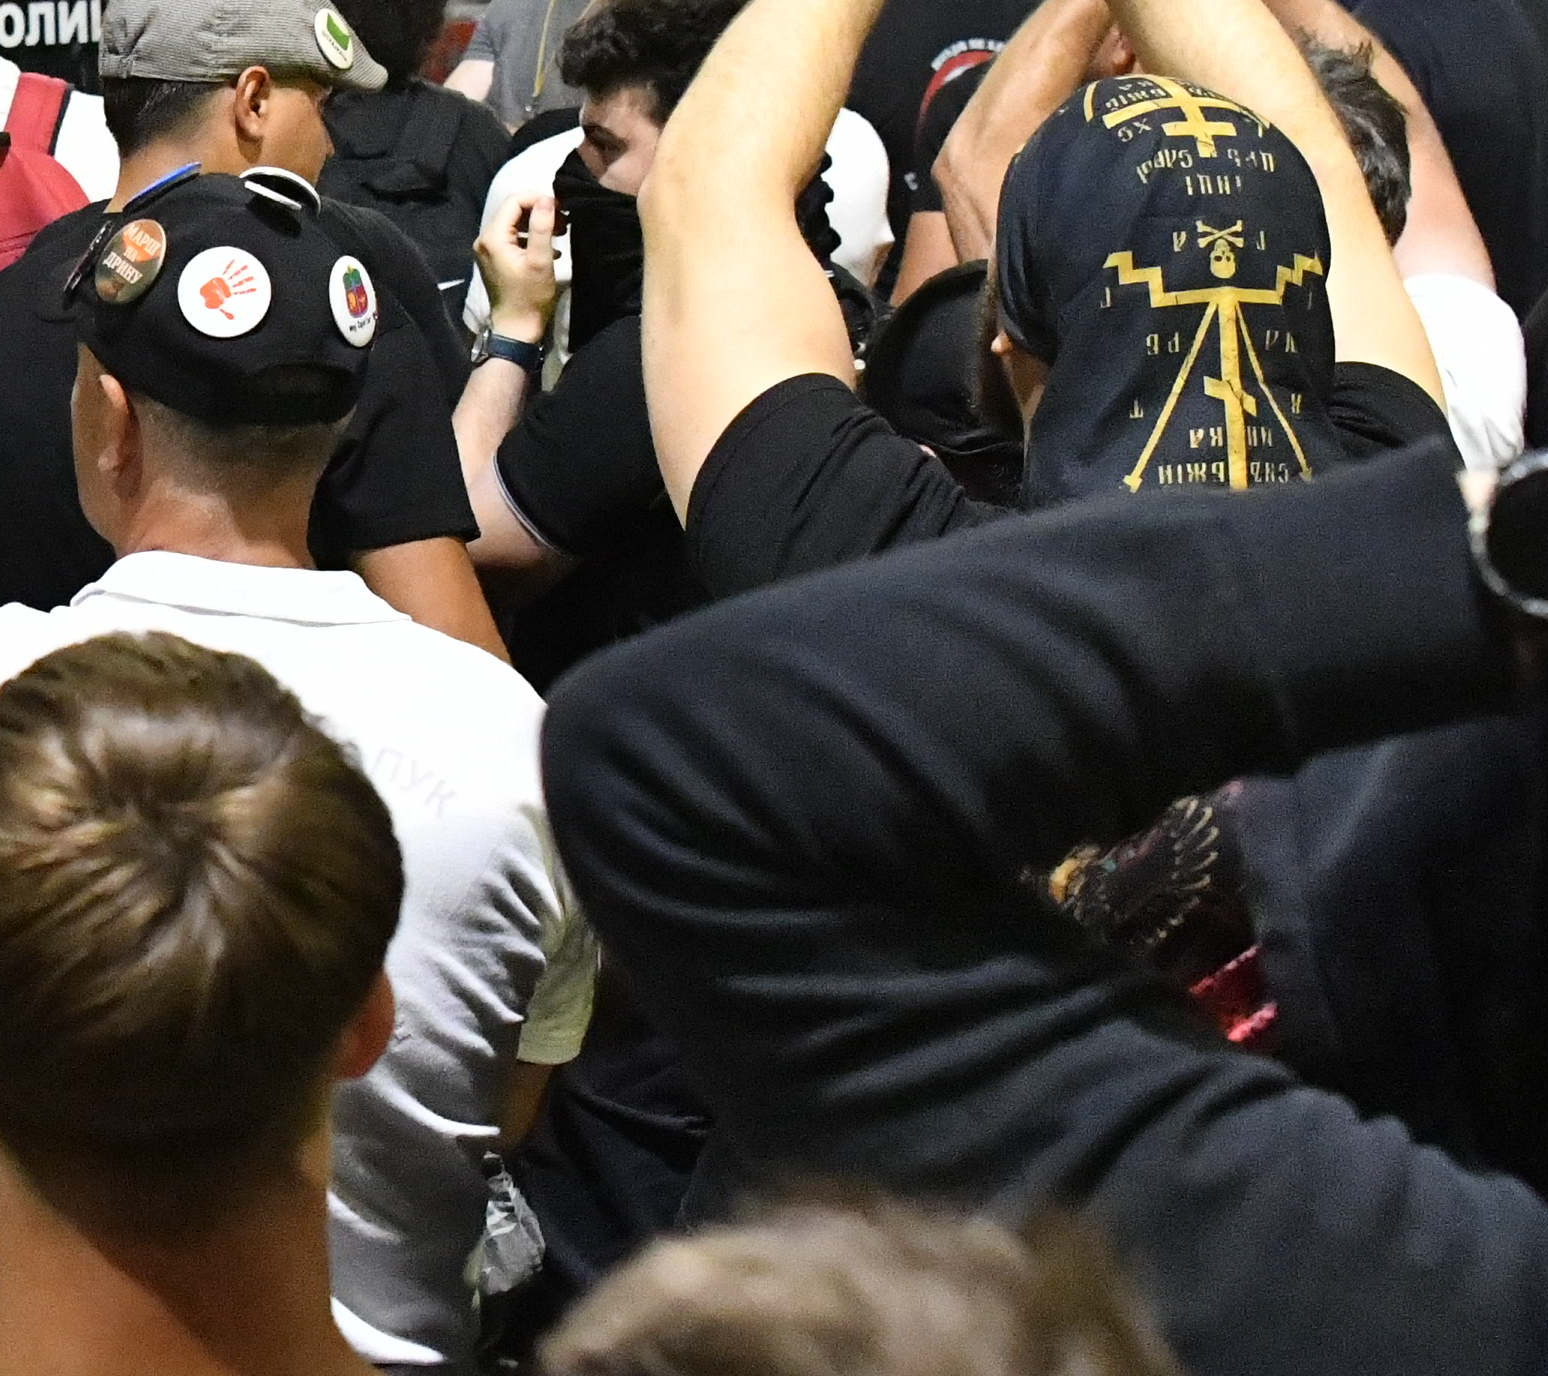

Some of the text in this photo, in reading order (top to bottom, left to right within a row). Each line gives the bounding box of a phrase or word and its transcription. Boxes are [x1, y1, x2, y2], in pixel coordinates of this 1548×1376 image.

[123, 223, 161, 256] МАРШ
[123, 246, 138, 262] НА
[102, 251, 143, 284] ДРИНУ
